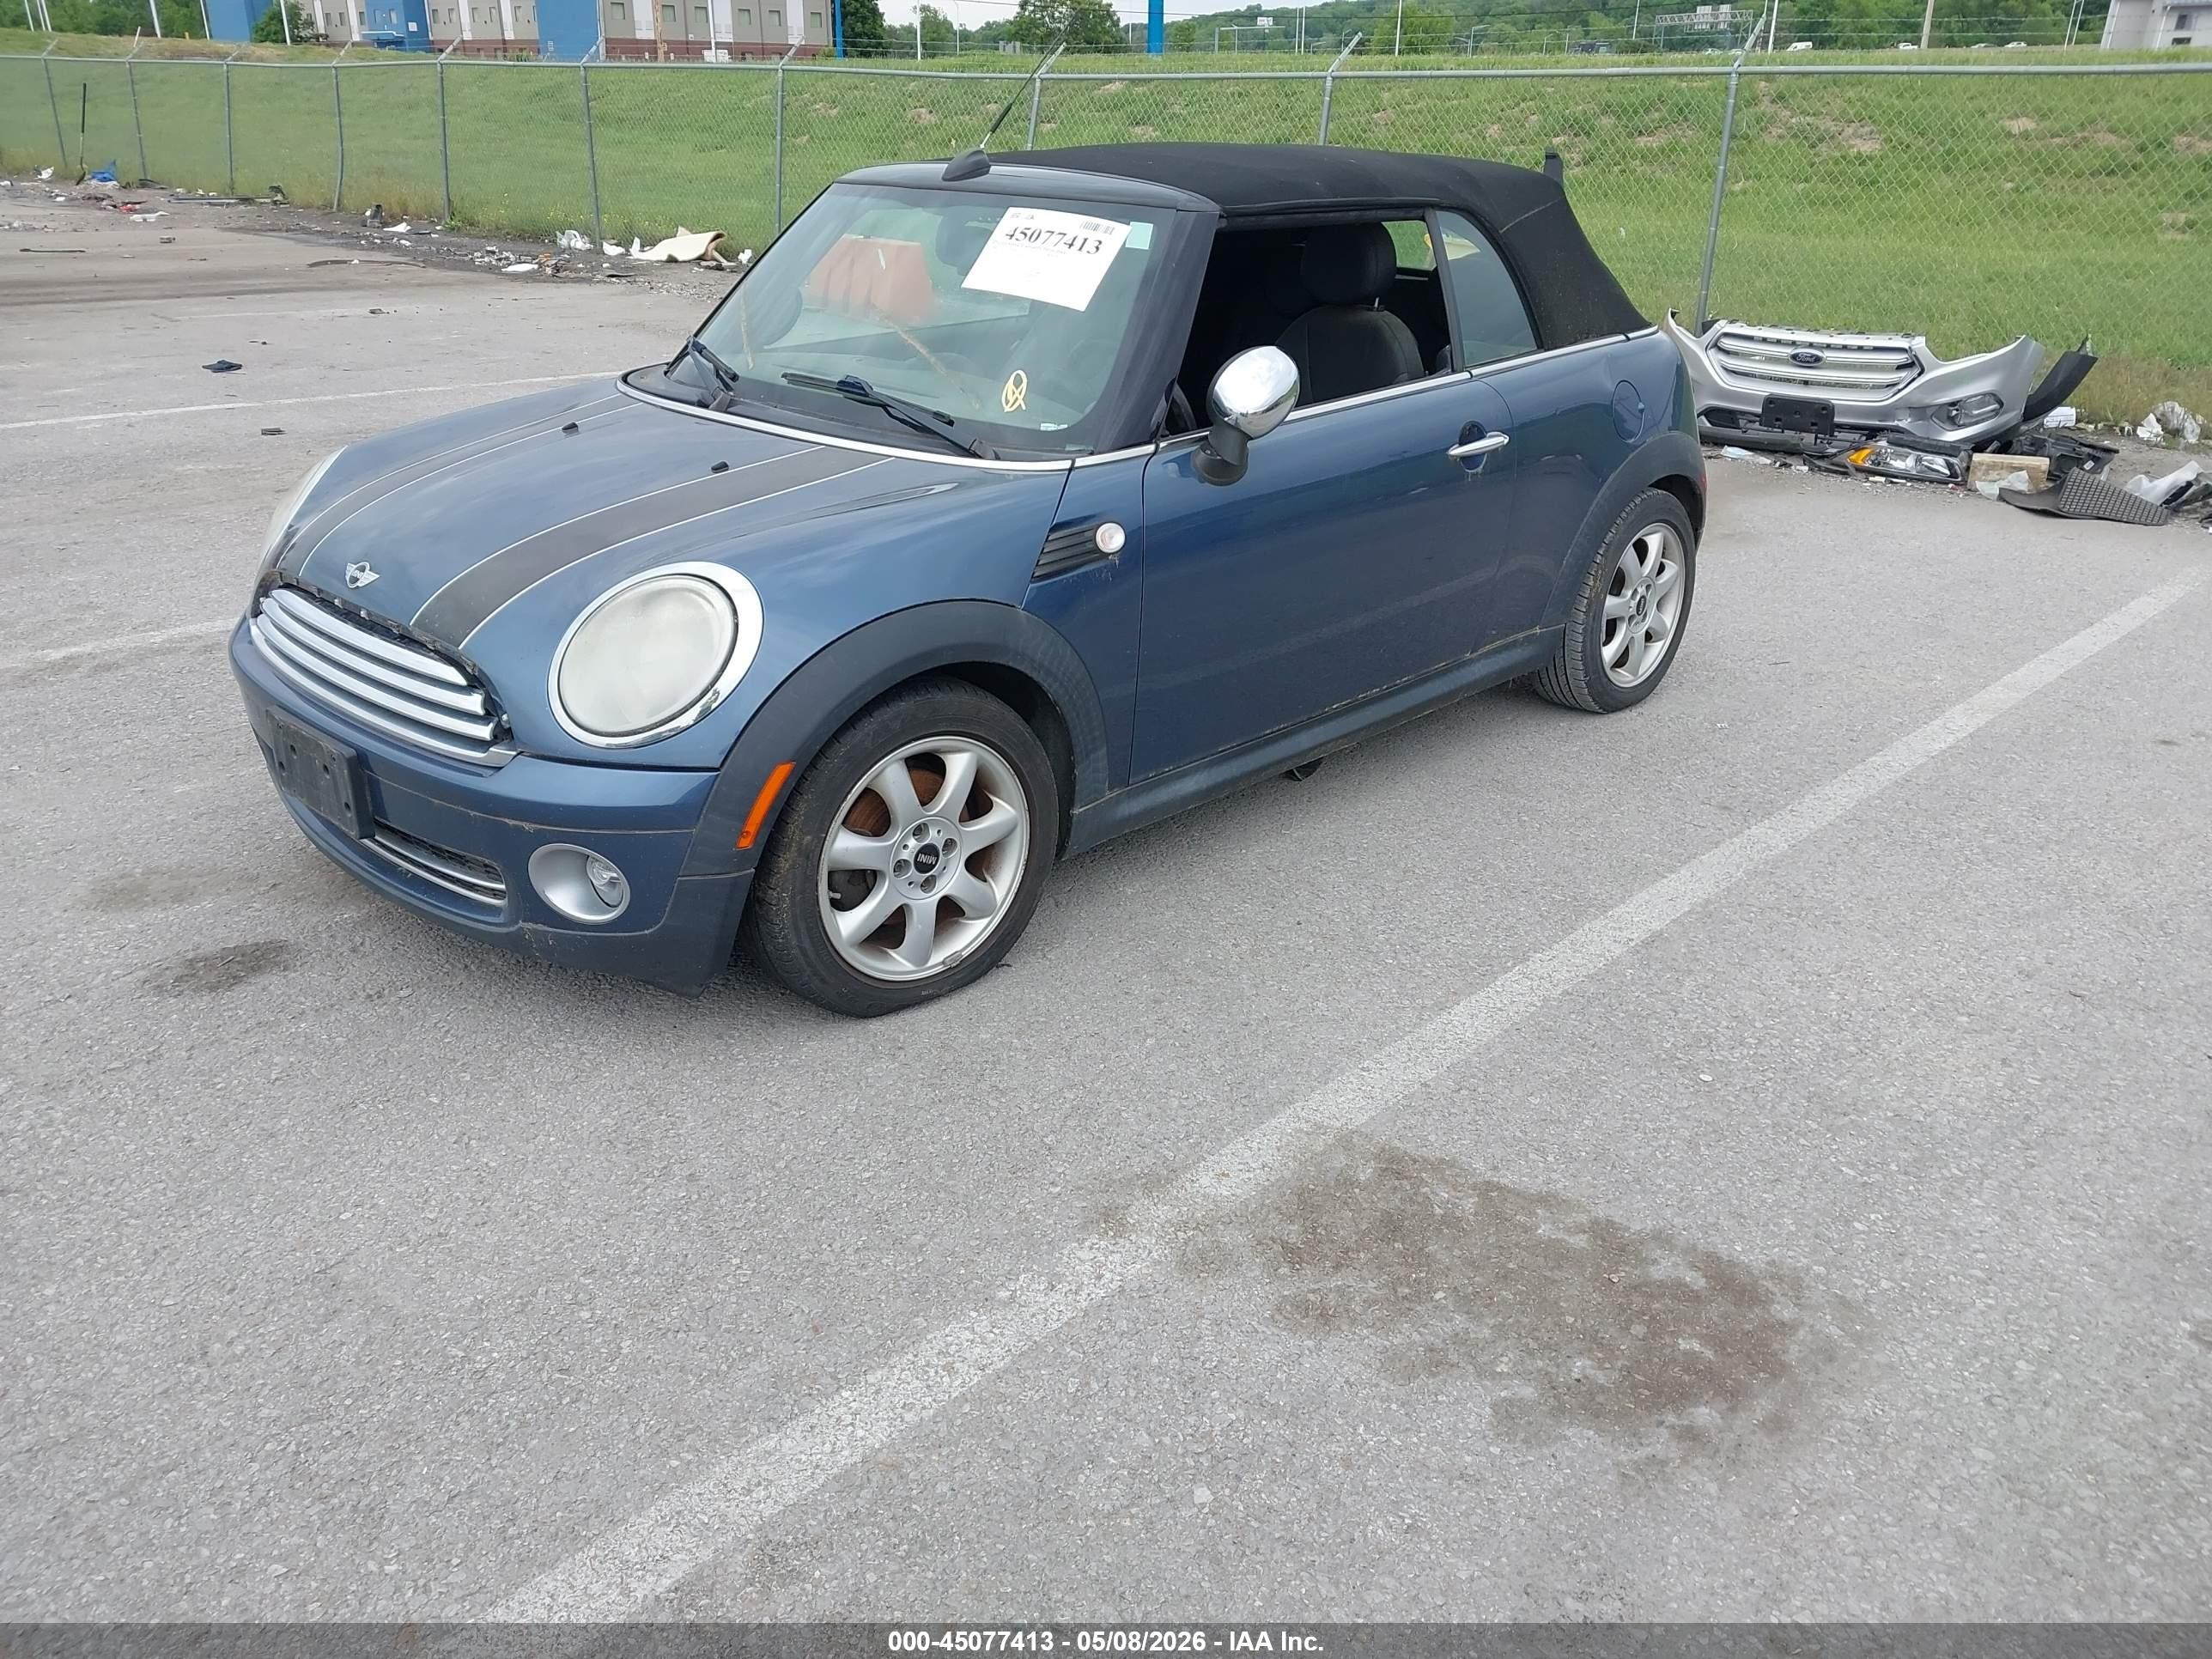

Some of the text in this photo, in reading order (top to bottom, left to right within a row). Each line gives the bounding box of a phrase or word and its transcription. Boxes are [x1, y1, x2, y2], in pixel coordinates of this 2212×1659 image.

[1006, 226, 1103, 255] 45077413
[1796, 352, 1817, 363] Ford
[916, 853, 938, 866] MINI
